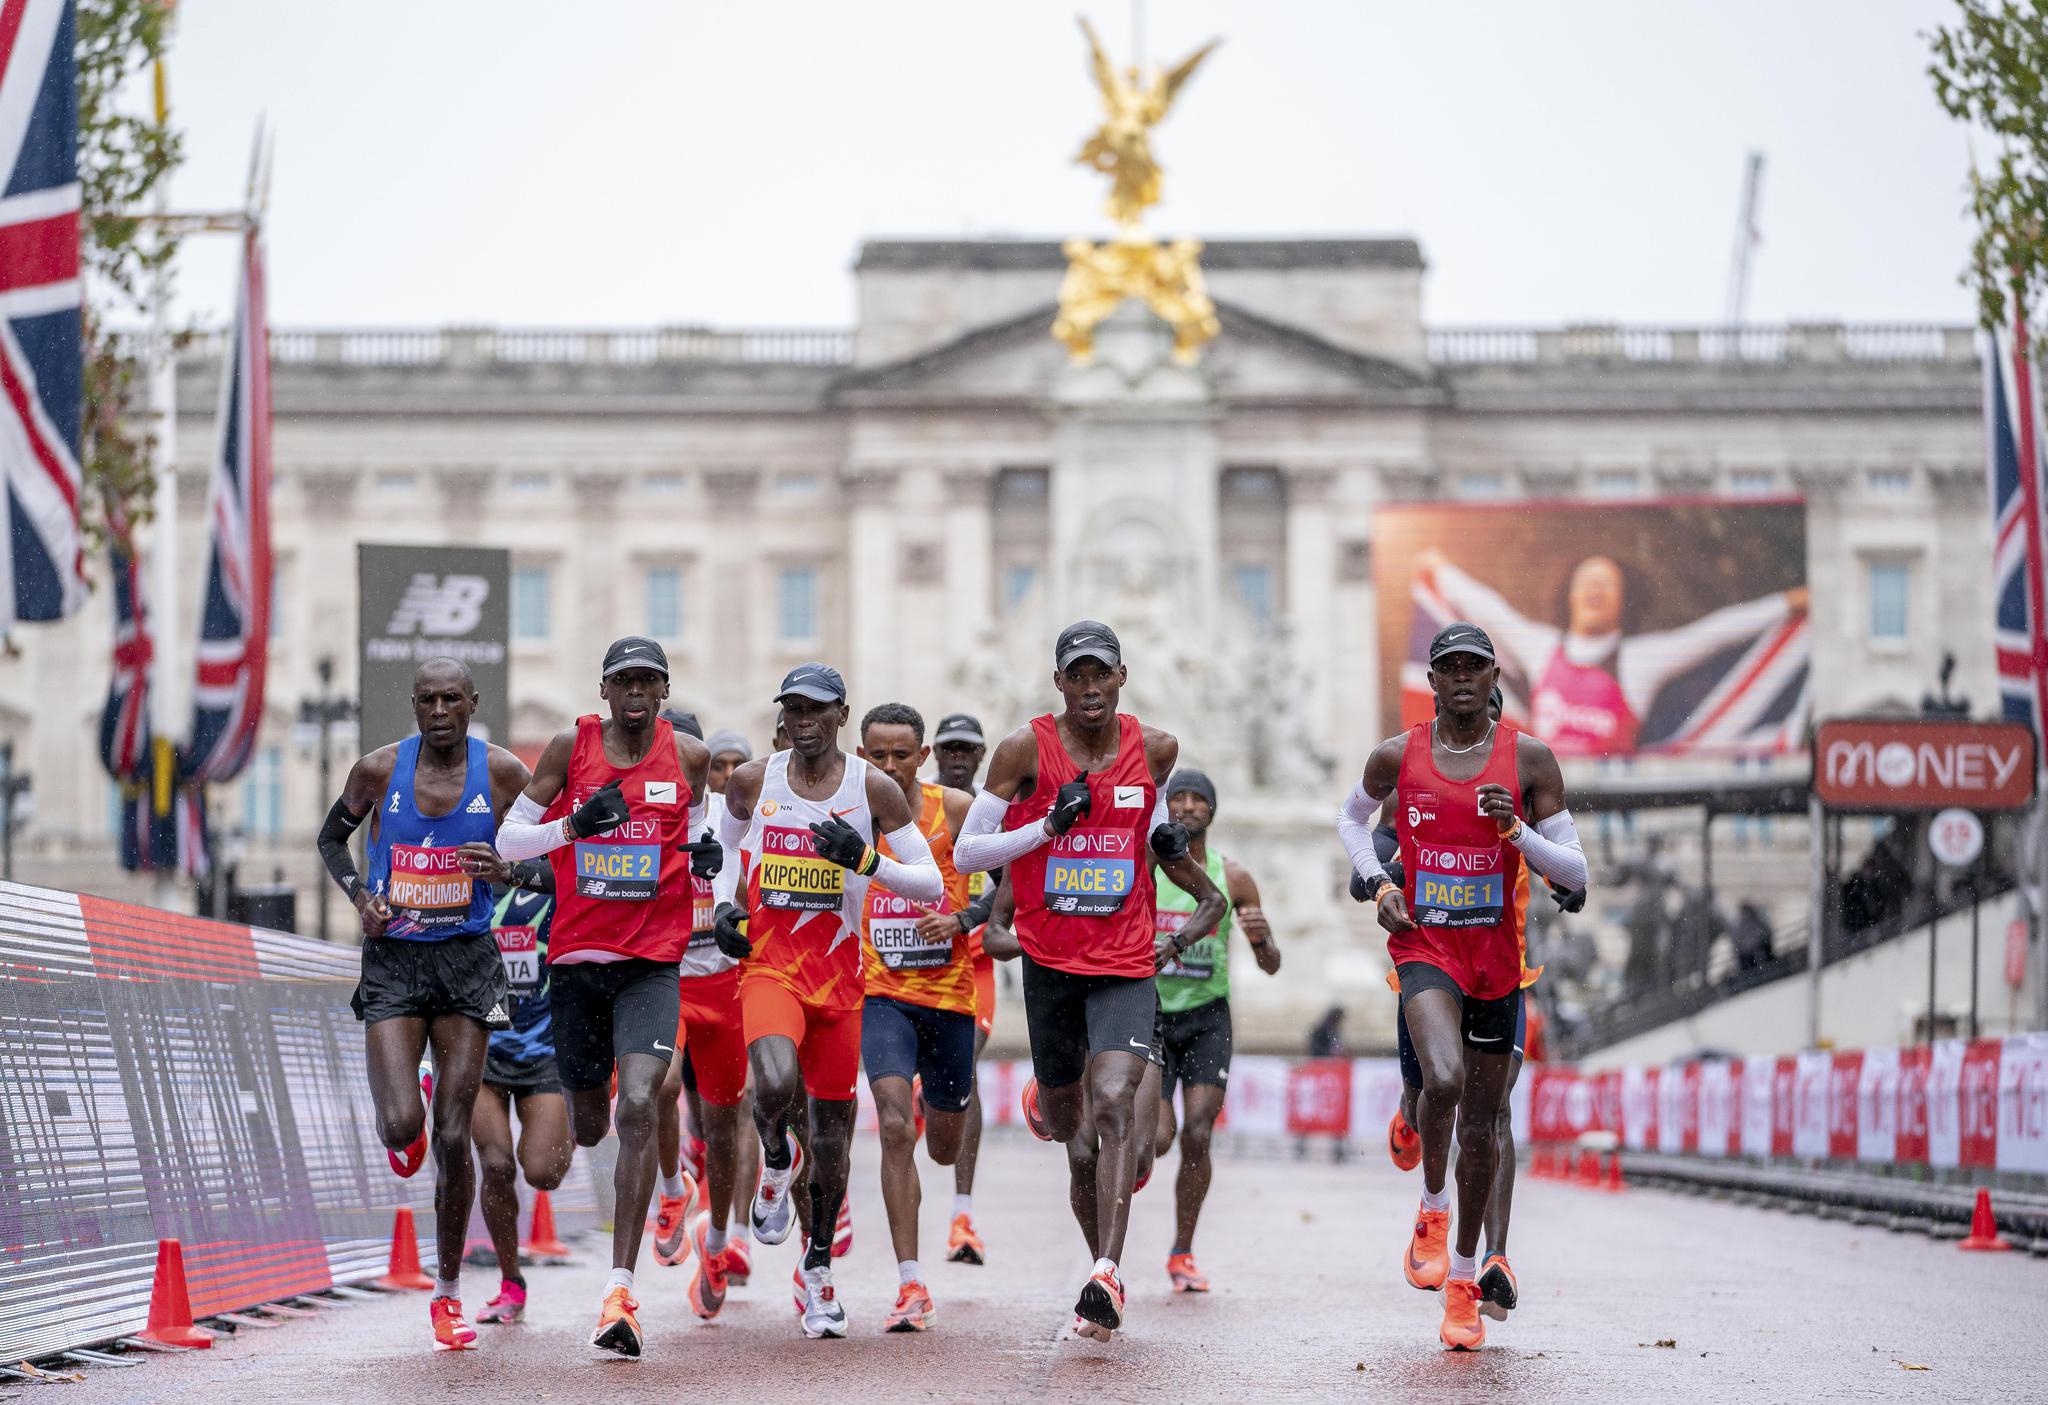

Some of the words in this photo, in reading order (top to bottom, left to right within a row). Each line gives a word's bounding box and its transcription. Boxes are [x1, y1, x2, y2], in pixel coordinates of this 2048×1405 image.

[1826, 740, 2021, 790] MONEY
[1422, 812, 1435, 820] NN
[766, 831, 815, 852] MON
[395, 849, 457, 870] MONE
[584, 852, 633, 877] PACE
[639, 855, 652, 877] 2
[1420, 848, 1499, 871] MONEY
[763, 863, 840, 889] KIPCHOGE
[1054, 867, 1106, 892] PACE
[1112, 869, 1125, 892] 3
[391, 881, 470, 905] KIPCHUMBA
[605, 889, 621, 897] new
[621, 888, 651, 898] balance
[1425, 881, 1476, 907] PACE
[1482, 883, 1491, 904] 1
[805, 900, 835, 909] balance
[1077, 904, 1094, 912] new
[436, 914, 464, 923] balance
[1464, 916, 1495, 925] balance
[917, 957, 946, 967] balance
